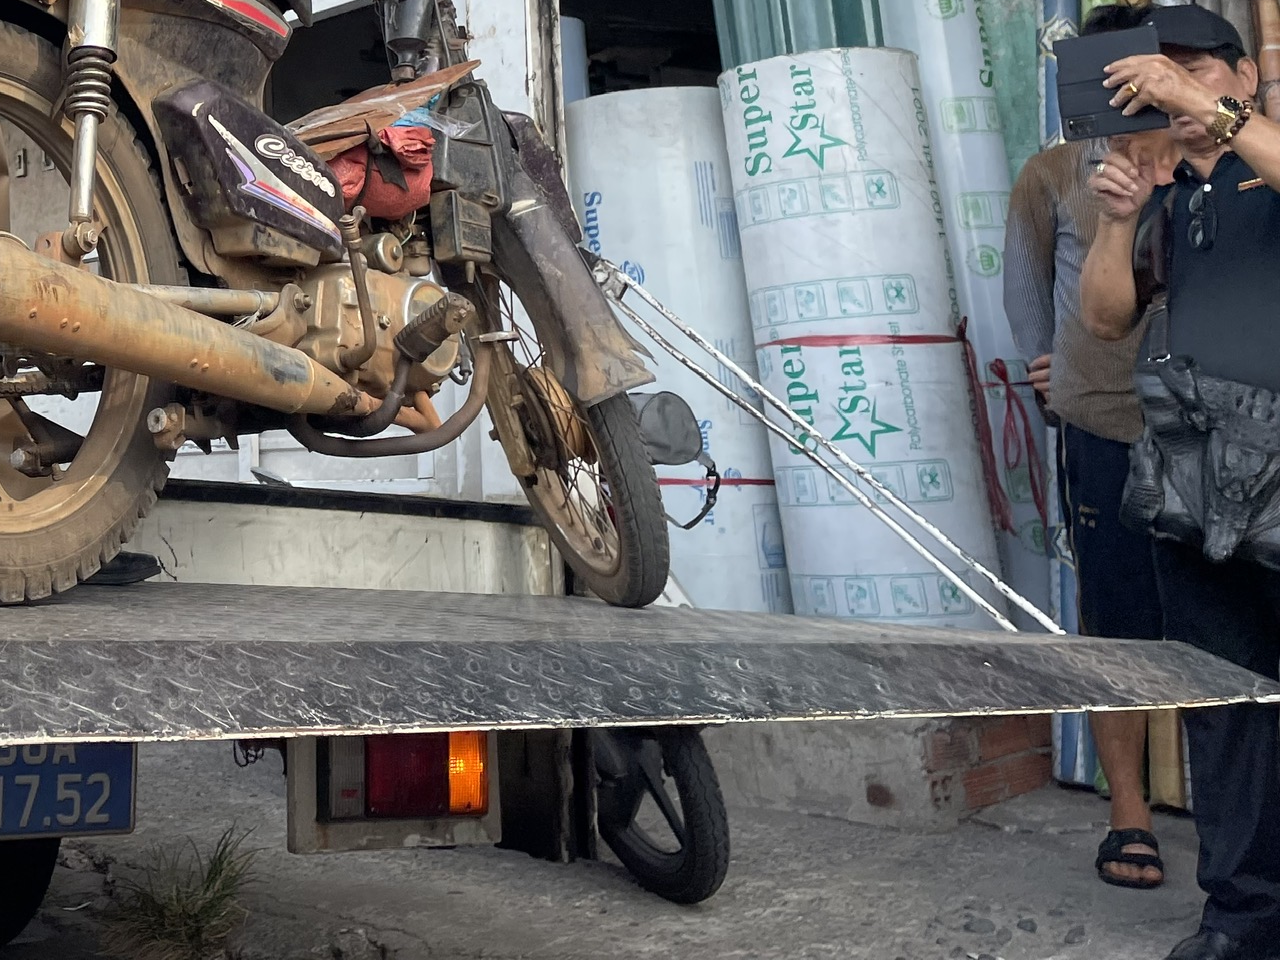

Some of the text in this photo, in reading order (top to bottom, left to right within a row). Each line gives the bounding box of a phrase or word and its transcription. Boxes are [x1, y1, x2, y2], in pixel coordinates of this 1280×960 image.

[735, 66, 774, 177] Super
[788, 64, 822, 132] Star
[845, 77, 869, 162] Polycarbonate
[583, 190, 603, 258] Supe
[896, 358, 923, 451] Polycarbonate
